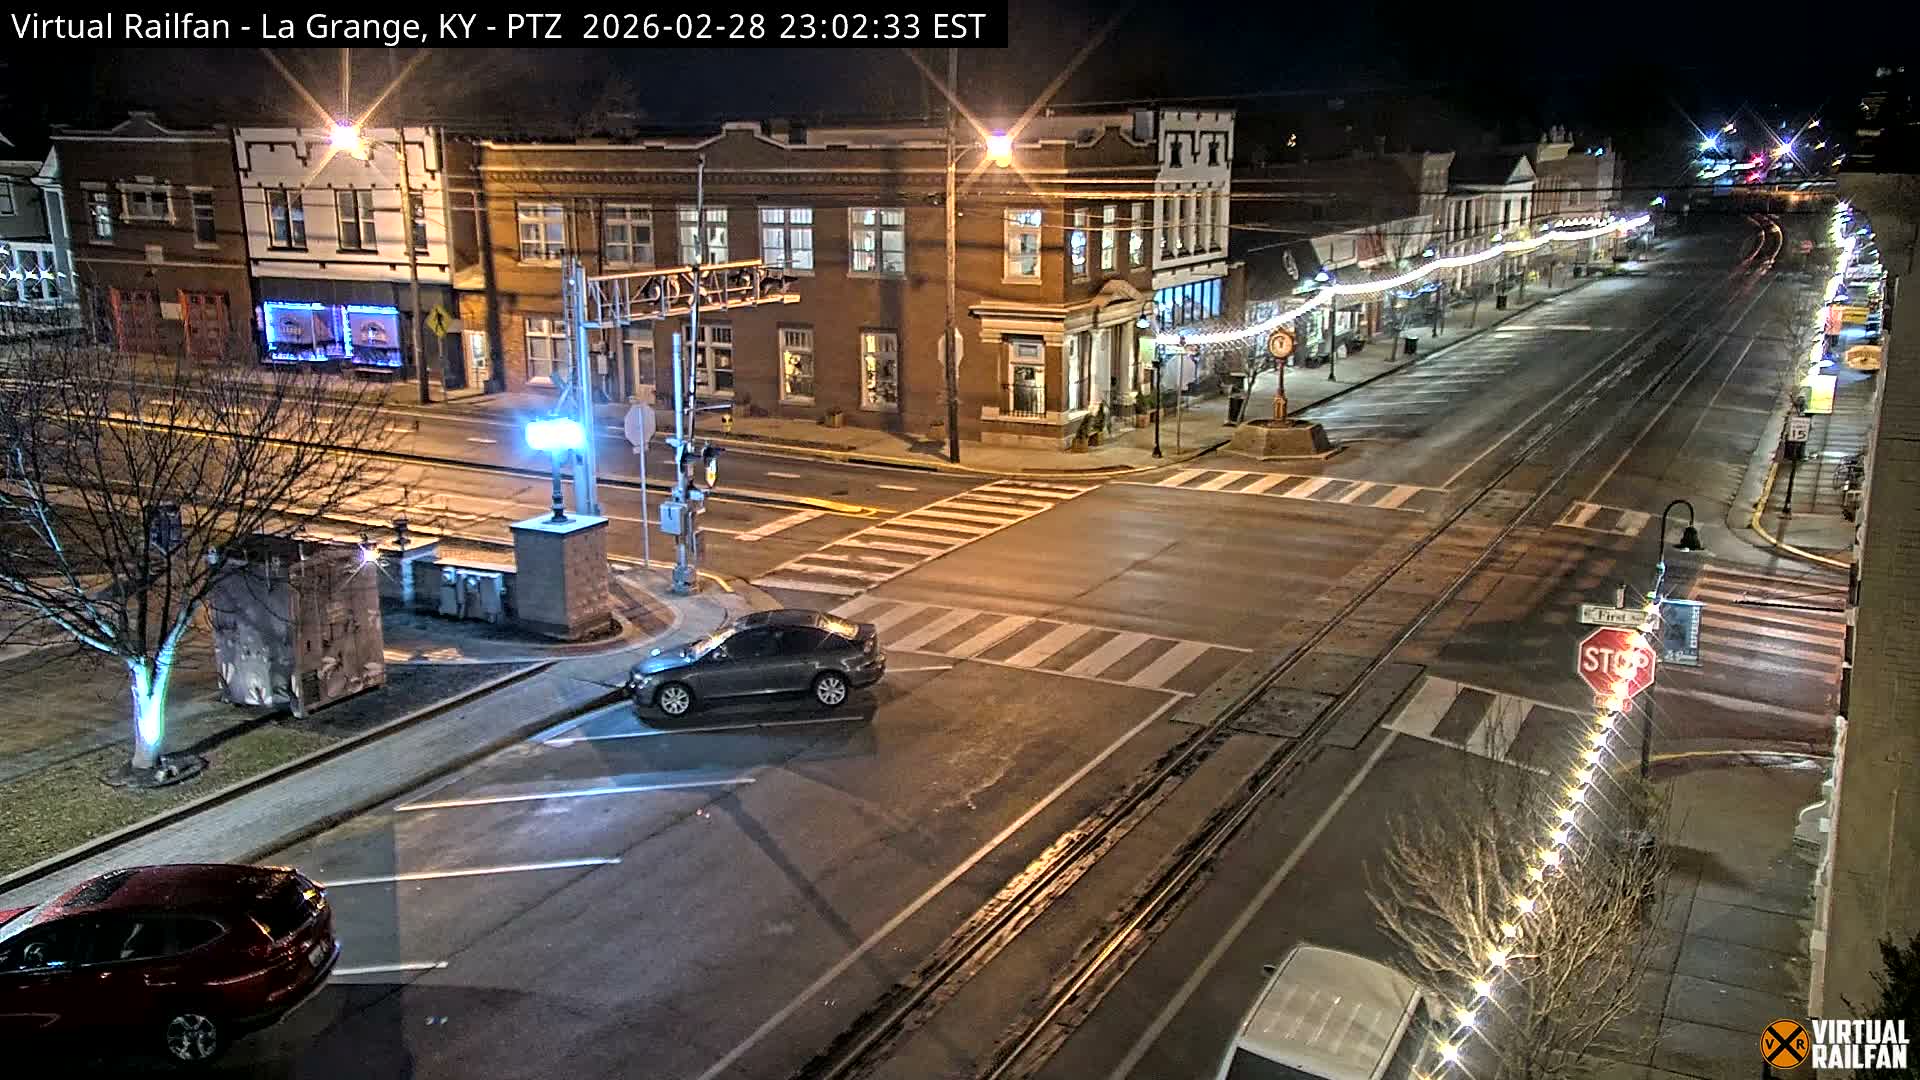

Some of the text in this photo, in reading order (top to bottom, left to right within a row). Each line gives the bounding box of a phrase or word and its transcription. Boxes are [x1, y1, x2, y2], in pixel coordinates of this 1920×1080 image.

[1792, 430, 1807, 440] 15
[1598, 610, 1626, 622] First
[1583, 647, 1650, 674] STOP
